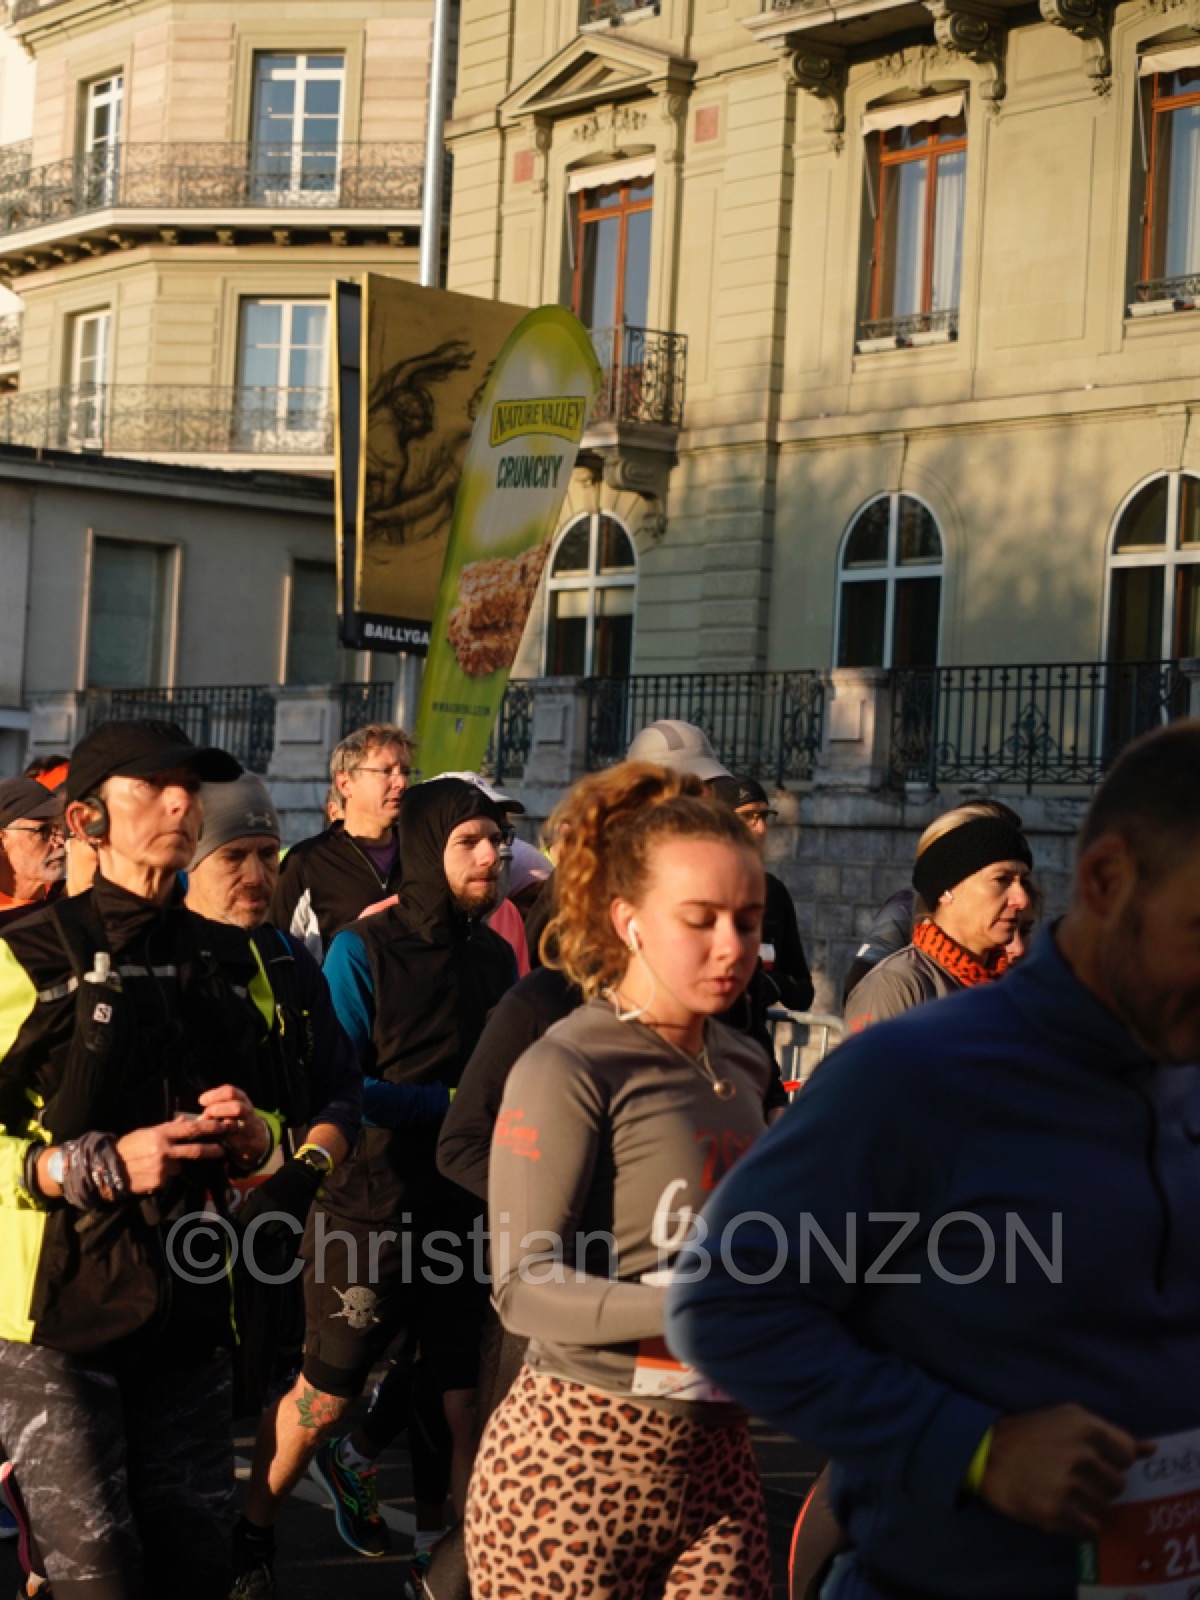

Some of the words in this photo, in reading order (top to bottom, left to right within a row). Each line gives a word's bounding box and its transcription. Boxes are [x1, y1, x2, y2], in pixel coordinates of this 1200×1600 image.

[494, 404, 541, 439] NATURE
[541, 402, 581, 431] VALLEY
[496, 455, 563, 489] CRUNCHY
